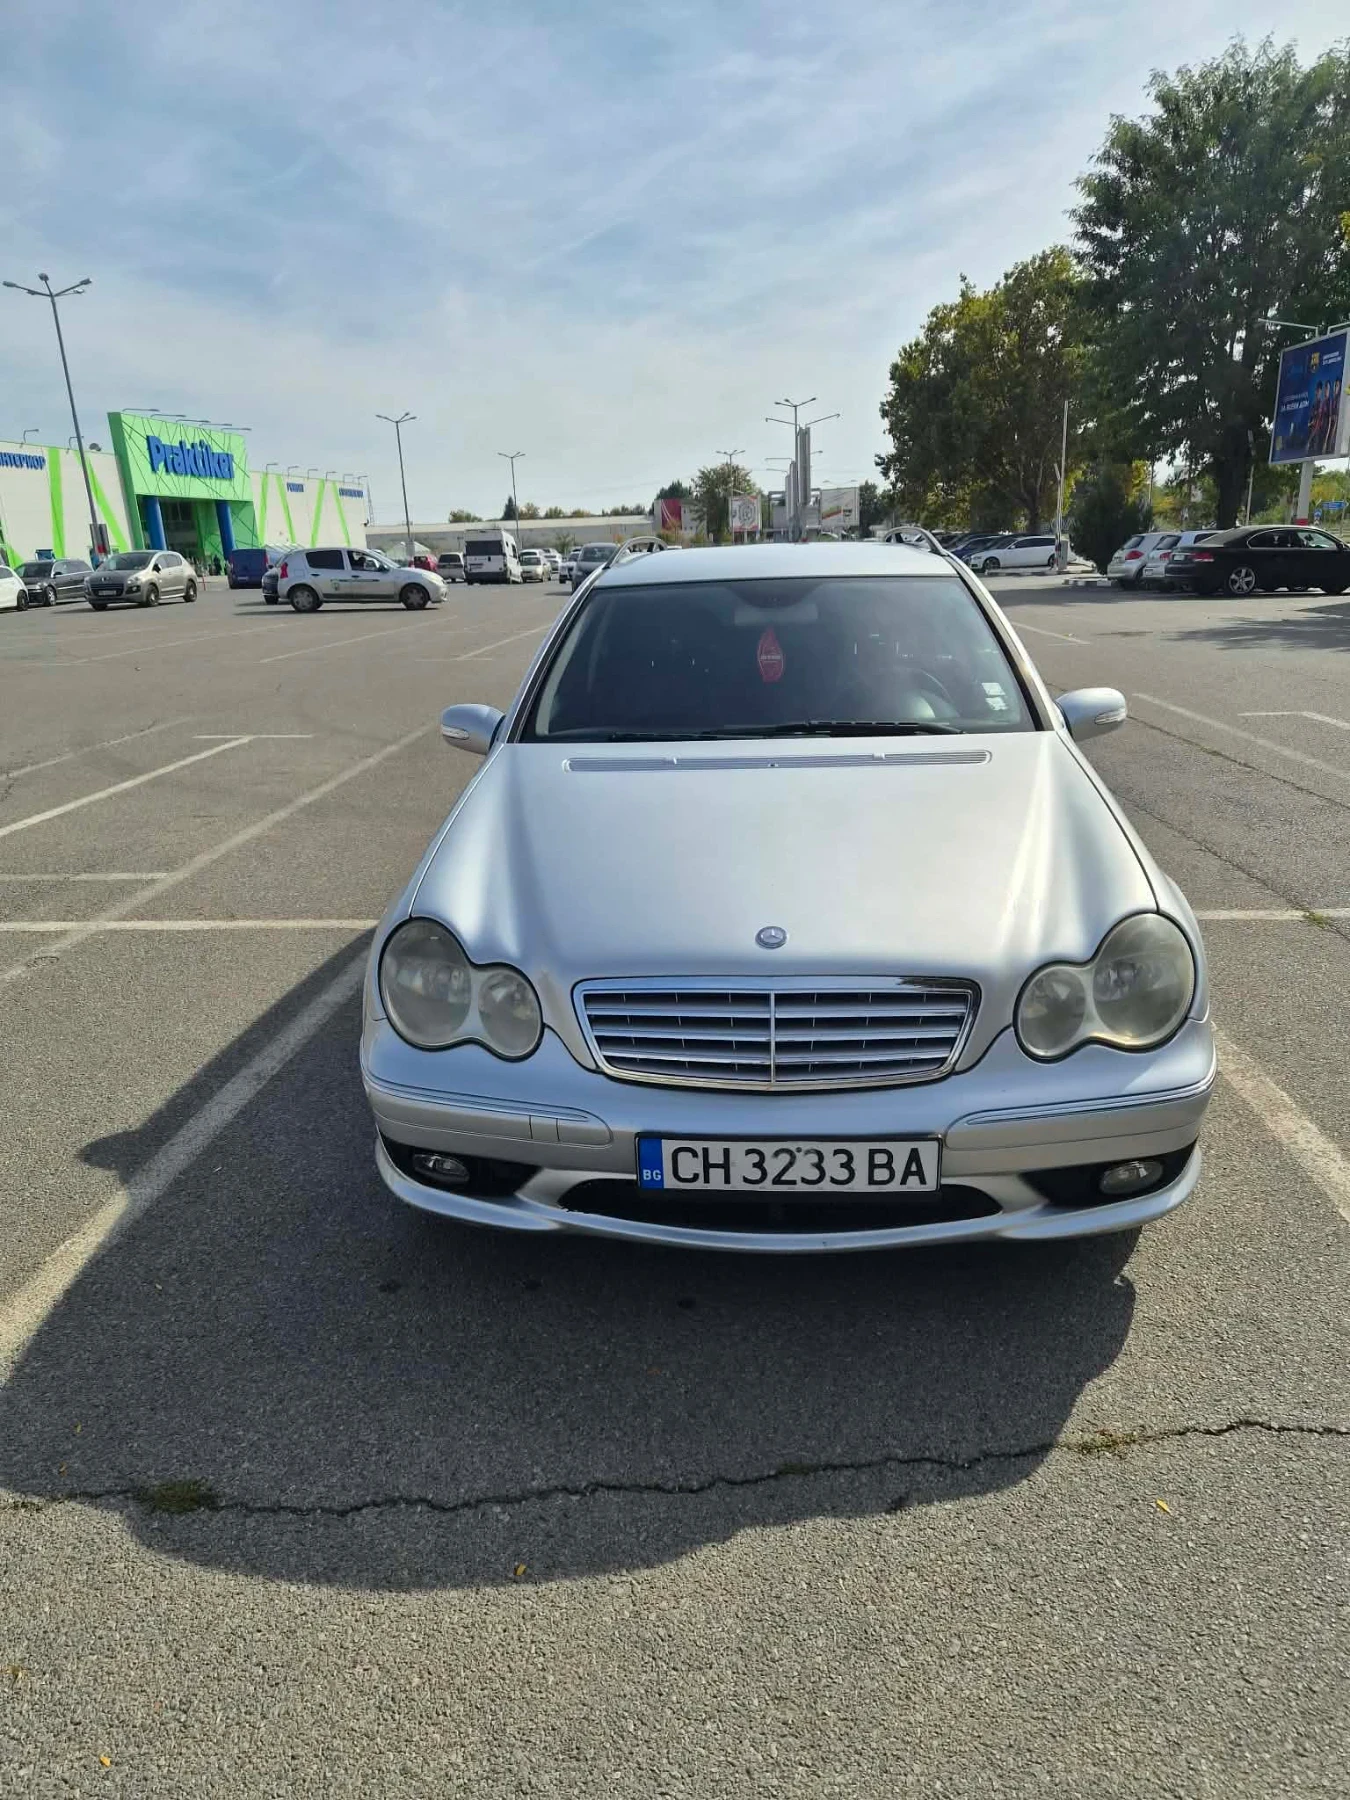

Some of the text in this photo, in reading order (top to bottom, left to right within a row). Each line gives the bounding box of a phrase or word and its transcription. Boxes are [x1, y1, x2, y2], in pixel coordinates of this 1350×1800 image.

[146, 435, 234, 479] Praktiker
[643, 1169, 661, 1181] BG
[672, 1147, 927, 1185] CH 3233 BA
